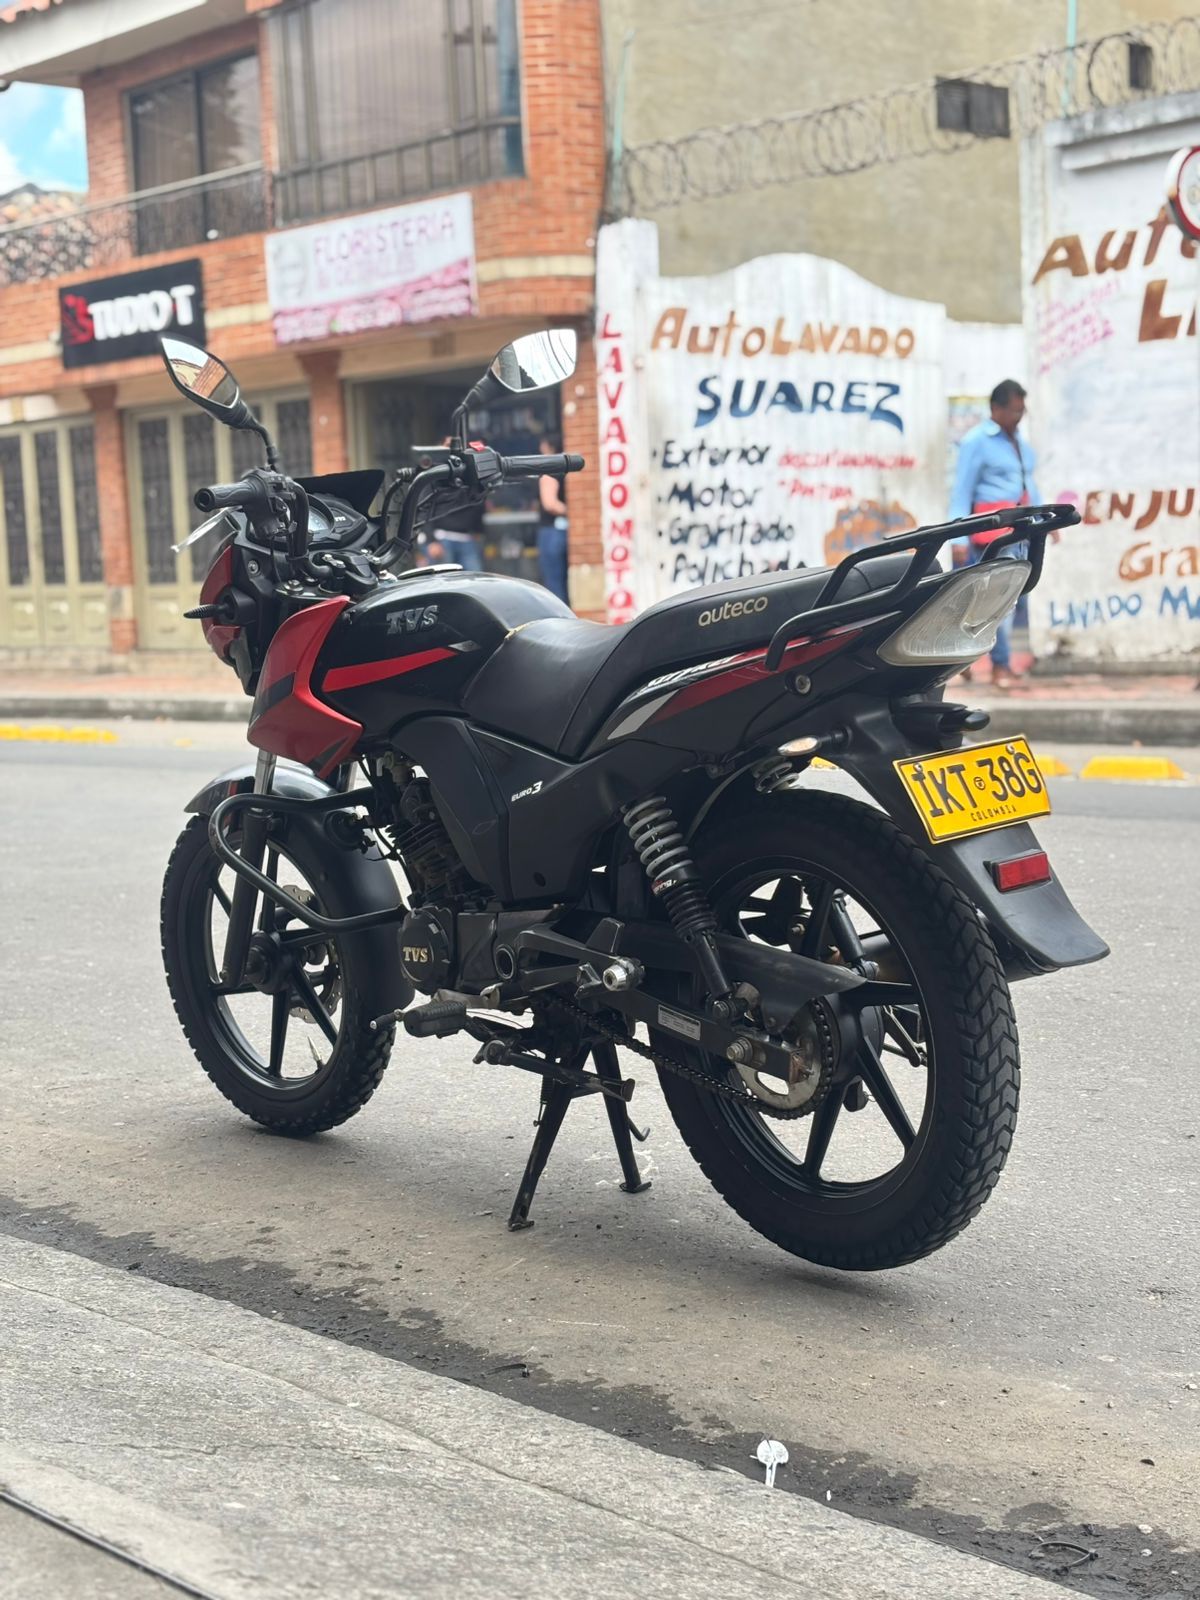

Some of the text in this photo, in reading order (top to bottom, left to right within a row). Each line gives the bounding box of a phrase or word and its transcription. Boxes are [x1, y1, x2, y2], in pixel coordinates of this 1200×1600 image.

[599, 312, 628, 509] LAVADO
[694, 375, 905, 433] SUAREZ
[662, 439, 771, 469] Exterior
[668, 477, 761, 512] Motor
[386, 604, 438, 635] TVS
[698, 596, 768, 627] auteco
[1050, 593, 1142, 628] LAVADO
[911, 752, 1042, 818] IKT 38G
[970, 807, 1017, 822] COLOMBIA
[402, 946, 428, 963] TVS
